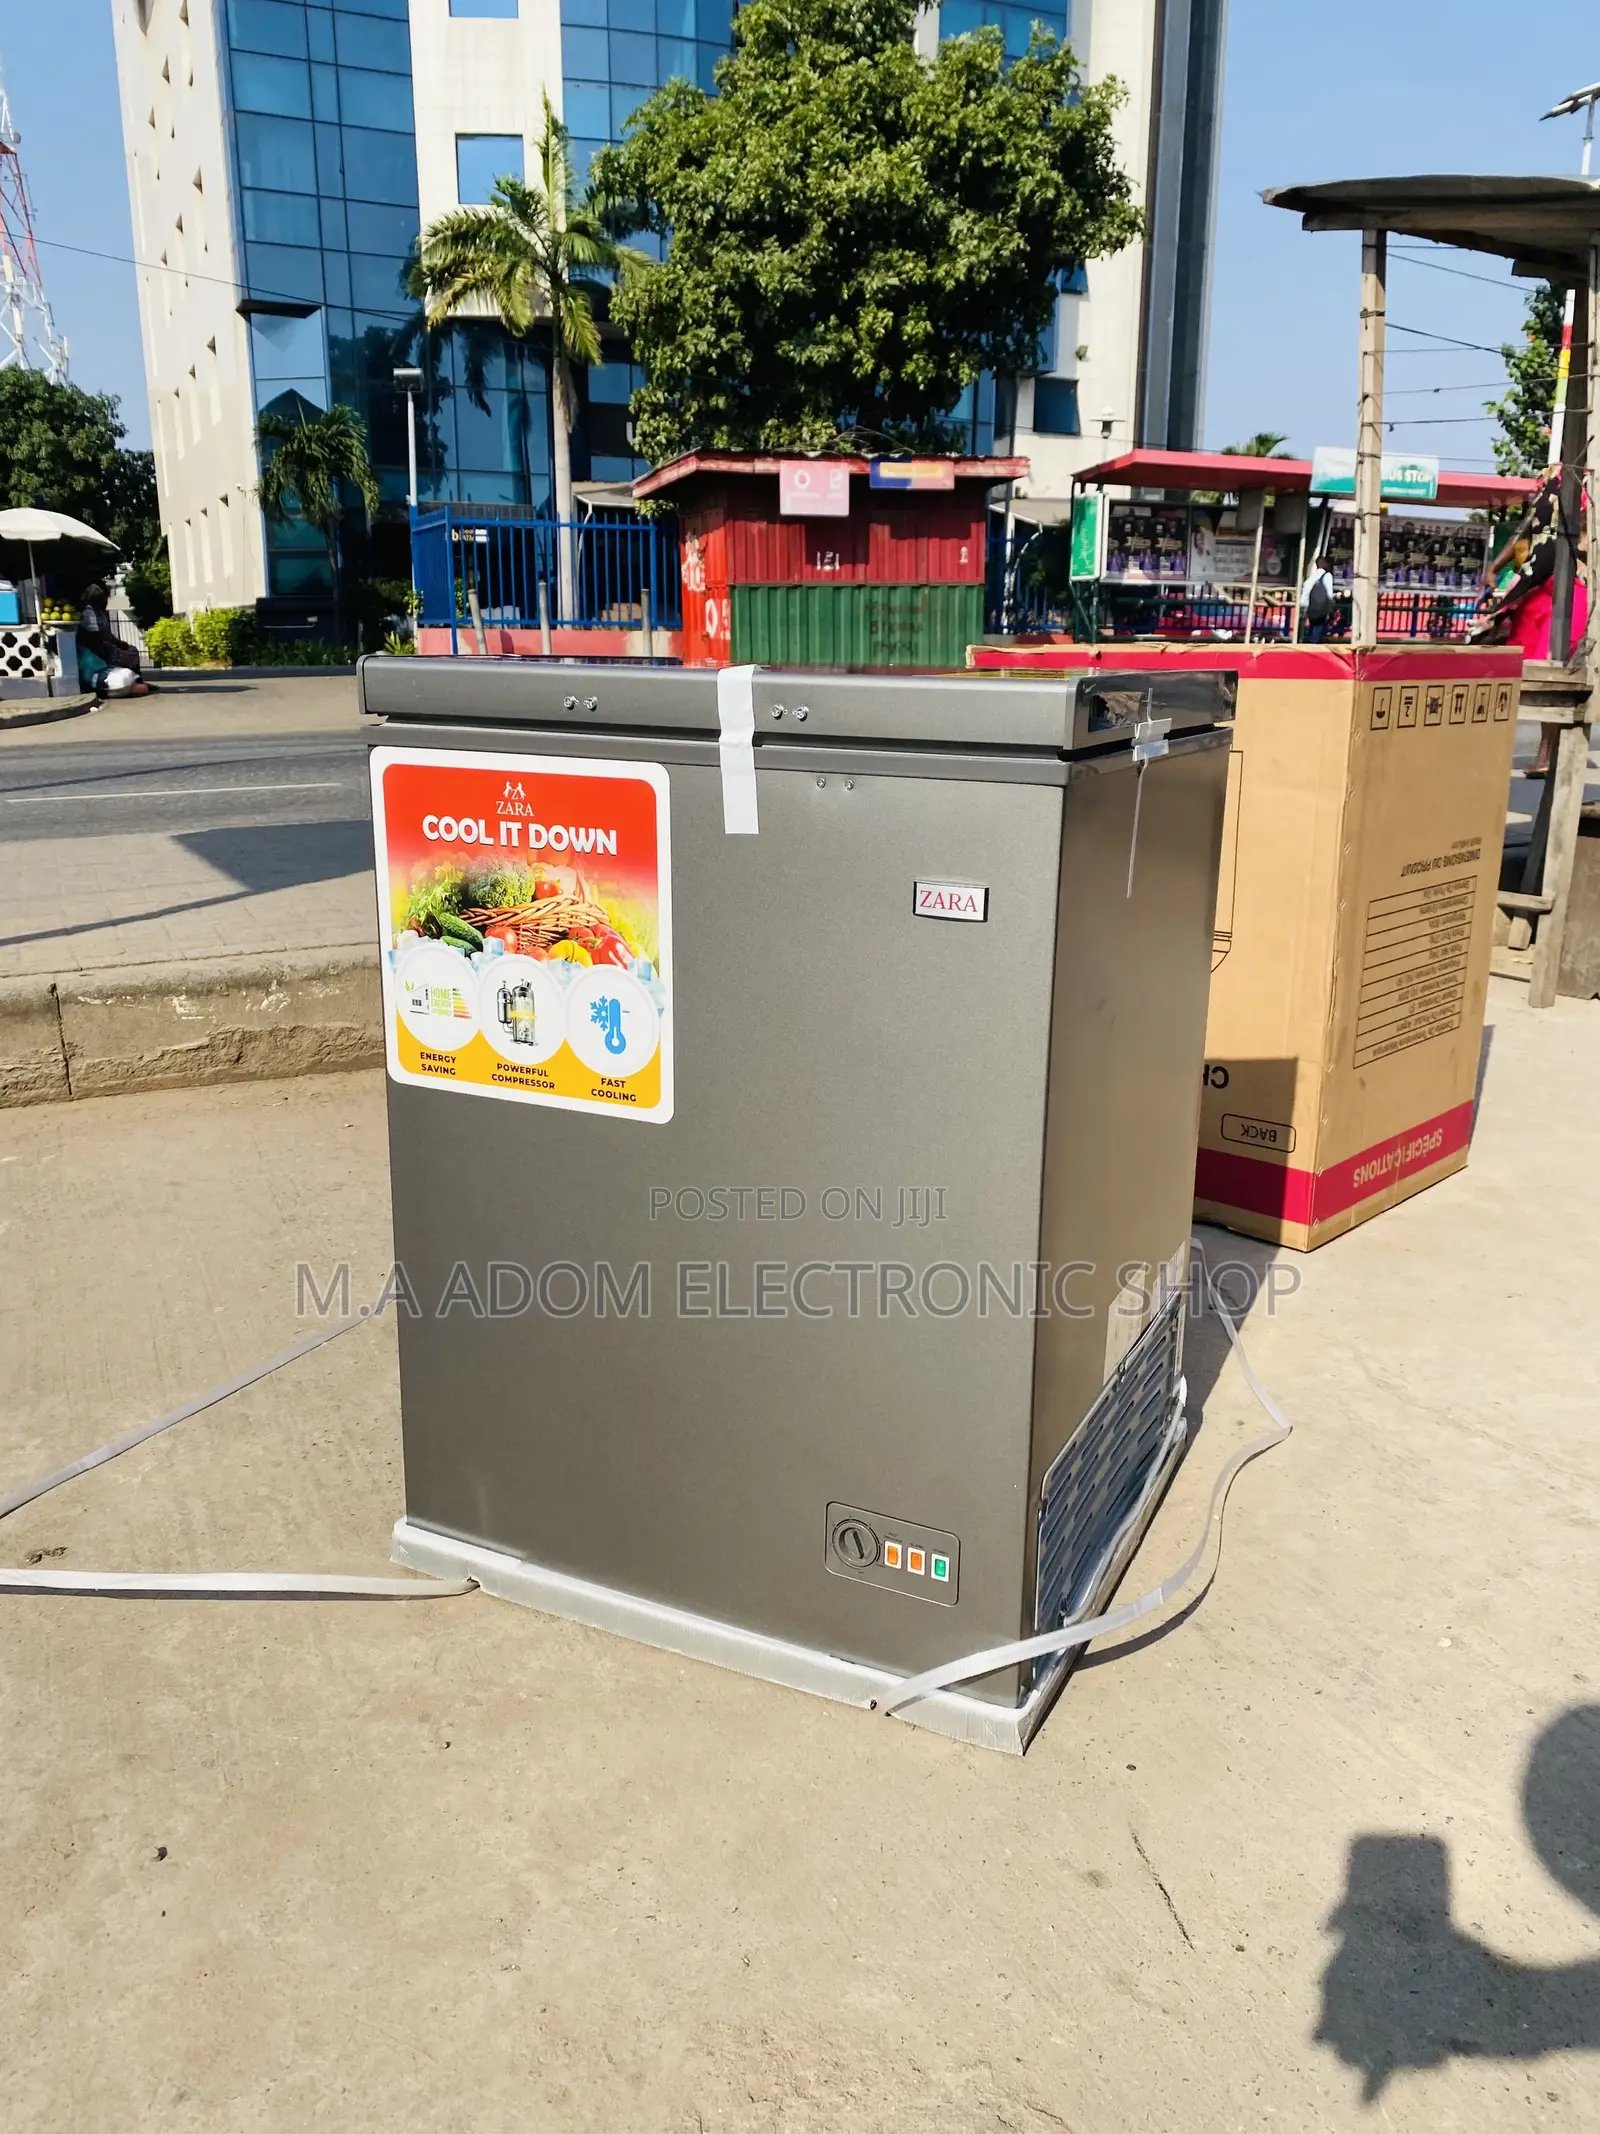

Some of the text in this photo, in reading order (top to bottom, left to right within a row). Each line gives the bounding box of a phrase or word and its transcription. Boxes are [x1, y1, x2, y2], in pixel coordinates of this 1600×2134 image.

[496, 800, 534, 817] ZARA
[422, 815, 618, 856] COOL IT DOWN
[920, 889, 978, 912] ZARA
[420, 1052, 456, 1064] ENERGY
[421, 1063, 456, 1076] SAVING
[496, 1063, 549, 1078] POWERFUL
[491, 1073, 555, 1090] COMPRESSOR
[600, 1077, 626, 1088] FAST
[591, 1088, 637, 1102] COOLING
[1240, 1123, 1277, 1143] BACK
